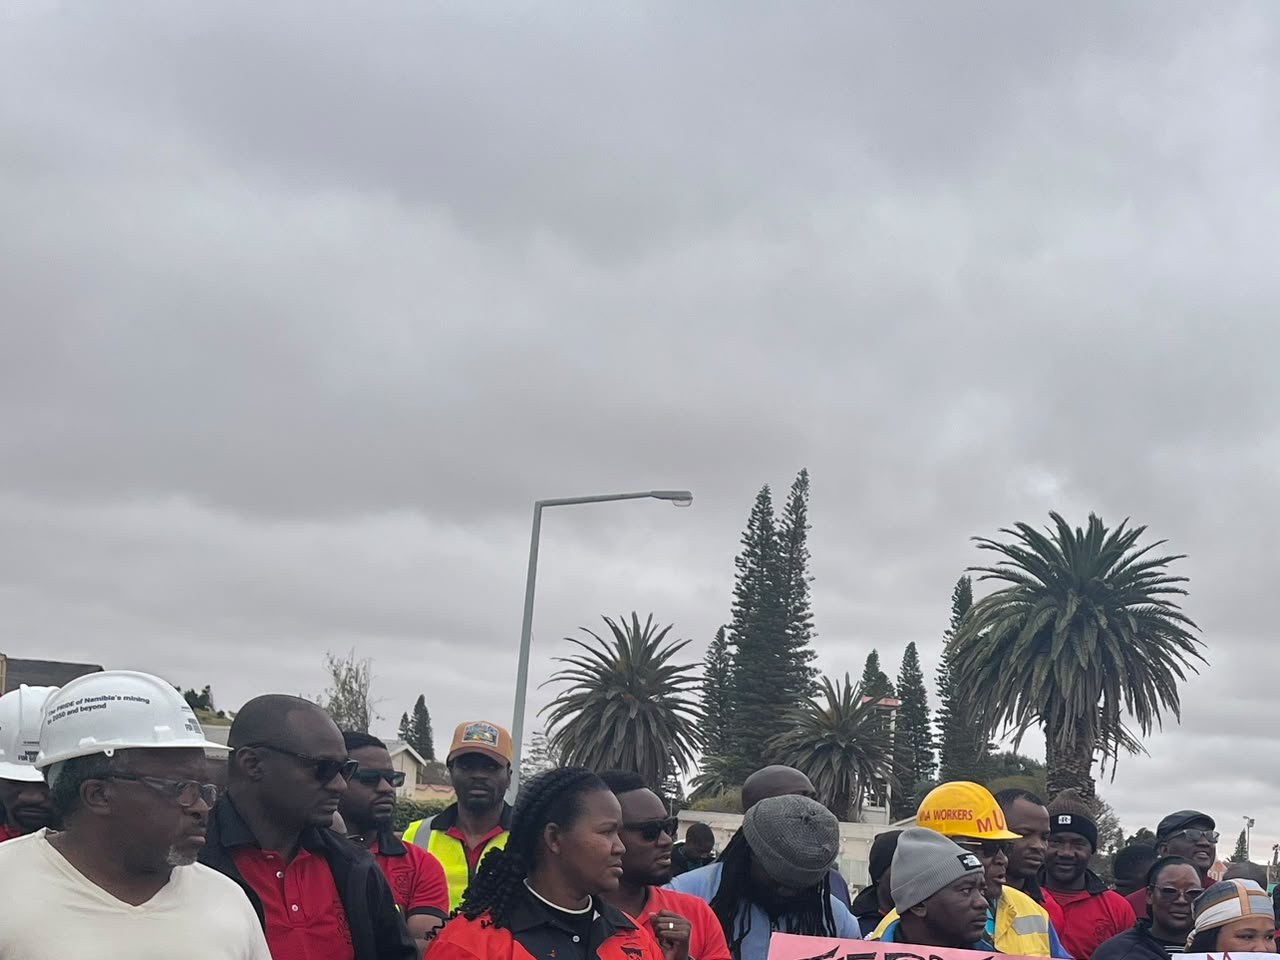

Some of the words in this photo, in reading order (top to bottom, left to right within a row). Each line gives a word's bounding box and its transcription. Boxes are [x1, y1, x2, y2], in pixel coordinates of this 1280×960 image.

[57, 701, 74, 711] PRIDE
[84, 695, 121, 704] Namibia's
[123, 696, 150, 704] mining
[67, 707, 79, 716] and
[80, 703, 107, 713] beyond
[934, 809, 973, 821] WORKERS
